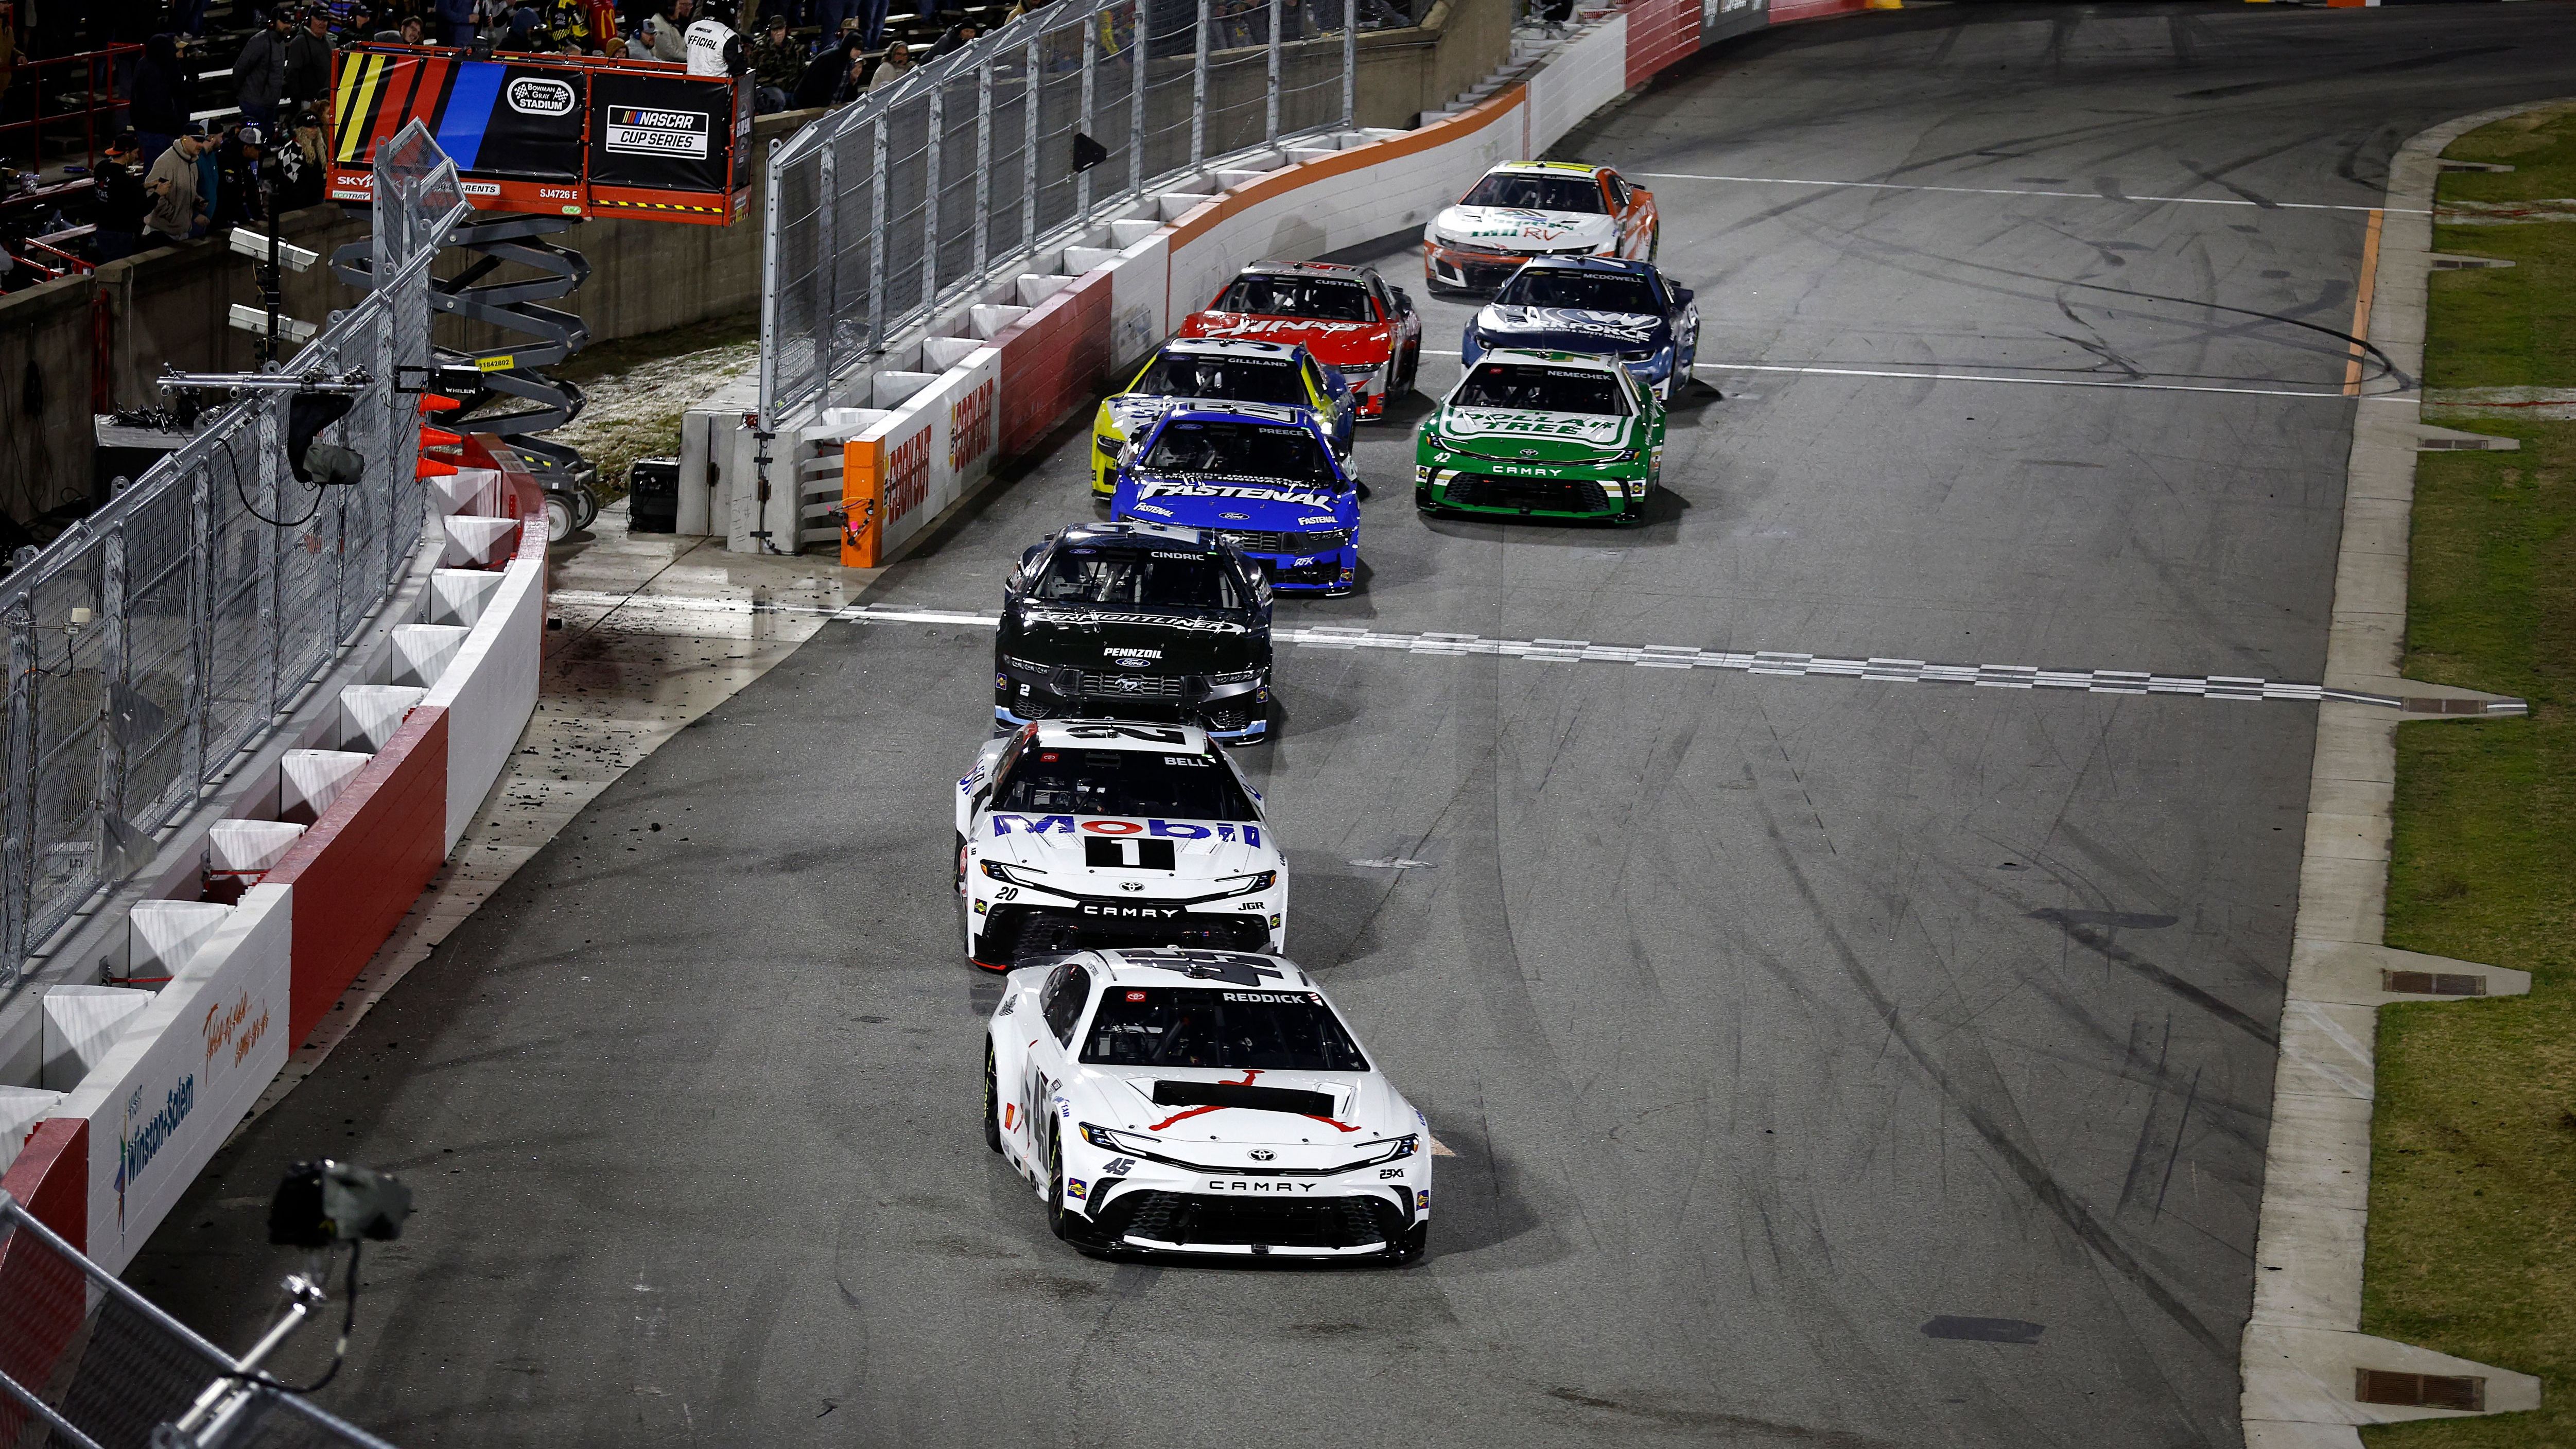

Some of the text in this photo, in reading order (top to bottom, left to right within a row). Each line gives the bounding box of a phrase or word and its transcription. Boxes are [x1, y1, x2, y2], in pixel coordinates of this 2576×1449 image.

[528, 83, 555, 92] BOWMAN
[520, 99, 562, 110] STADIUM
[639, 112, 694, 129] NASCAR
[620, 131, 693, 148] CUP SERIES
[337, 174, 373, 188] SKYJ
[540, 188, 578, 200] SJ4726 E
[1524, 227, 1565, 241] RV
[1315, 279, 1357, 288] CUSTER
[1583, 273, 1644, 283] MCDOWELL
[1504, 319, 1651, 341] ORKFORCE
[1228, 357, 1287, 367] GILLILAND
[1547, 370, 1612, 381] NEMECHEK
[1259, 428, 1304, 437] PREECE
[1483, 422, 1582, 435] TREE
[1434, 452, 1451, 462] 42
[1493, 466, 1562, 477] CAMRY
[1139, 482, 1333, 512] FASTENAL
[1133, 502, 1174, 517] FASTENAL
[1298, 516, 1338, 526] FASTENAL
[1151, 551, 1205, 561] CINDRIC
[1294, 556, 1315, 566] RFK
[1103, 648, 1163, 659] PENNZOIL
[1020, 684, 1031, 696] 2
[1165, 757, 1210, 767] BELL
[993, 815, 1261, 848] Mobil
[1111, 839, 1142, 866] 1
[995, 886, 1019, 901] 20
[1085, 905, 1179, 918] CAMRY
[1238, 901, 1265, 911] JGR
[1223, 992, 1306, 1004] REDDICK
[1102, 1157, 1136, 1176] 45
[1069, 1185, 1087, 1195] SUNOCO
[1209, 1180, 1316, 1193] CAMRY
